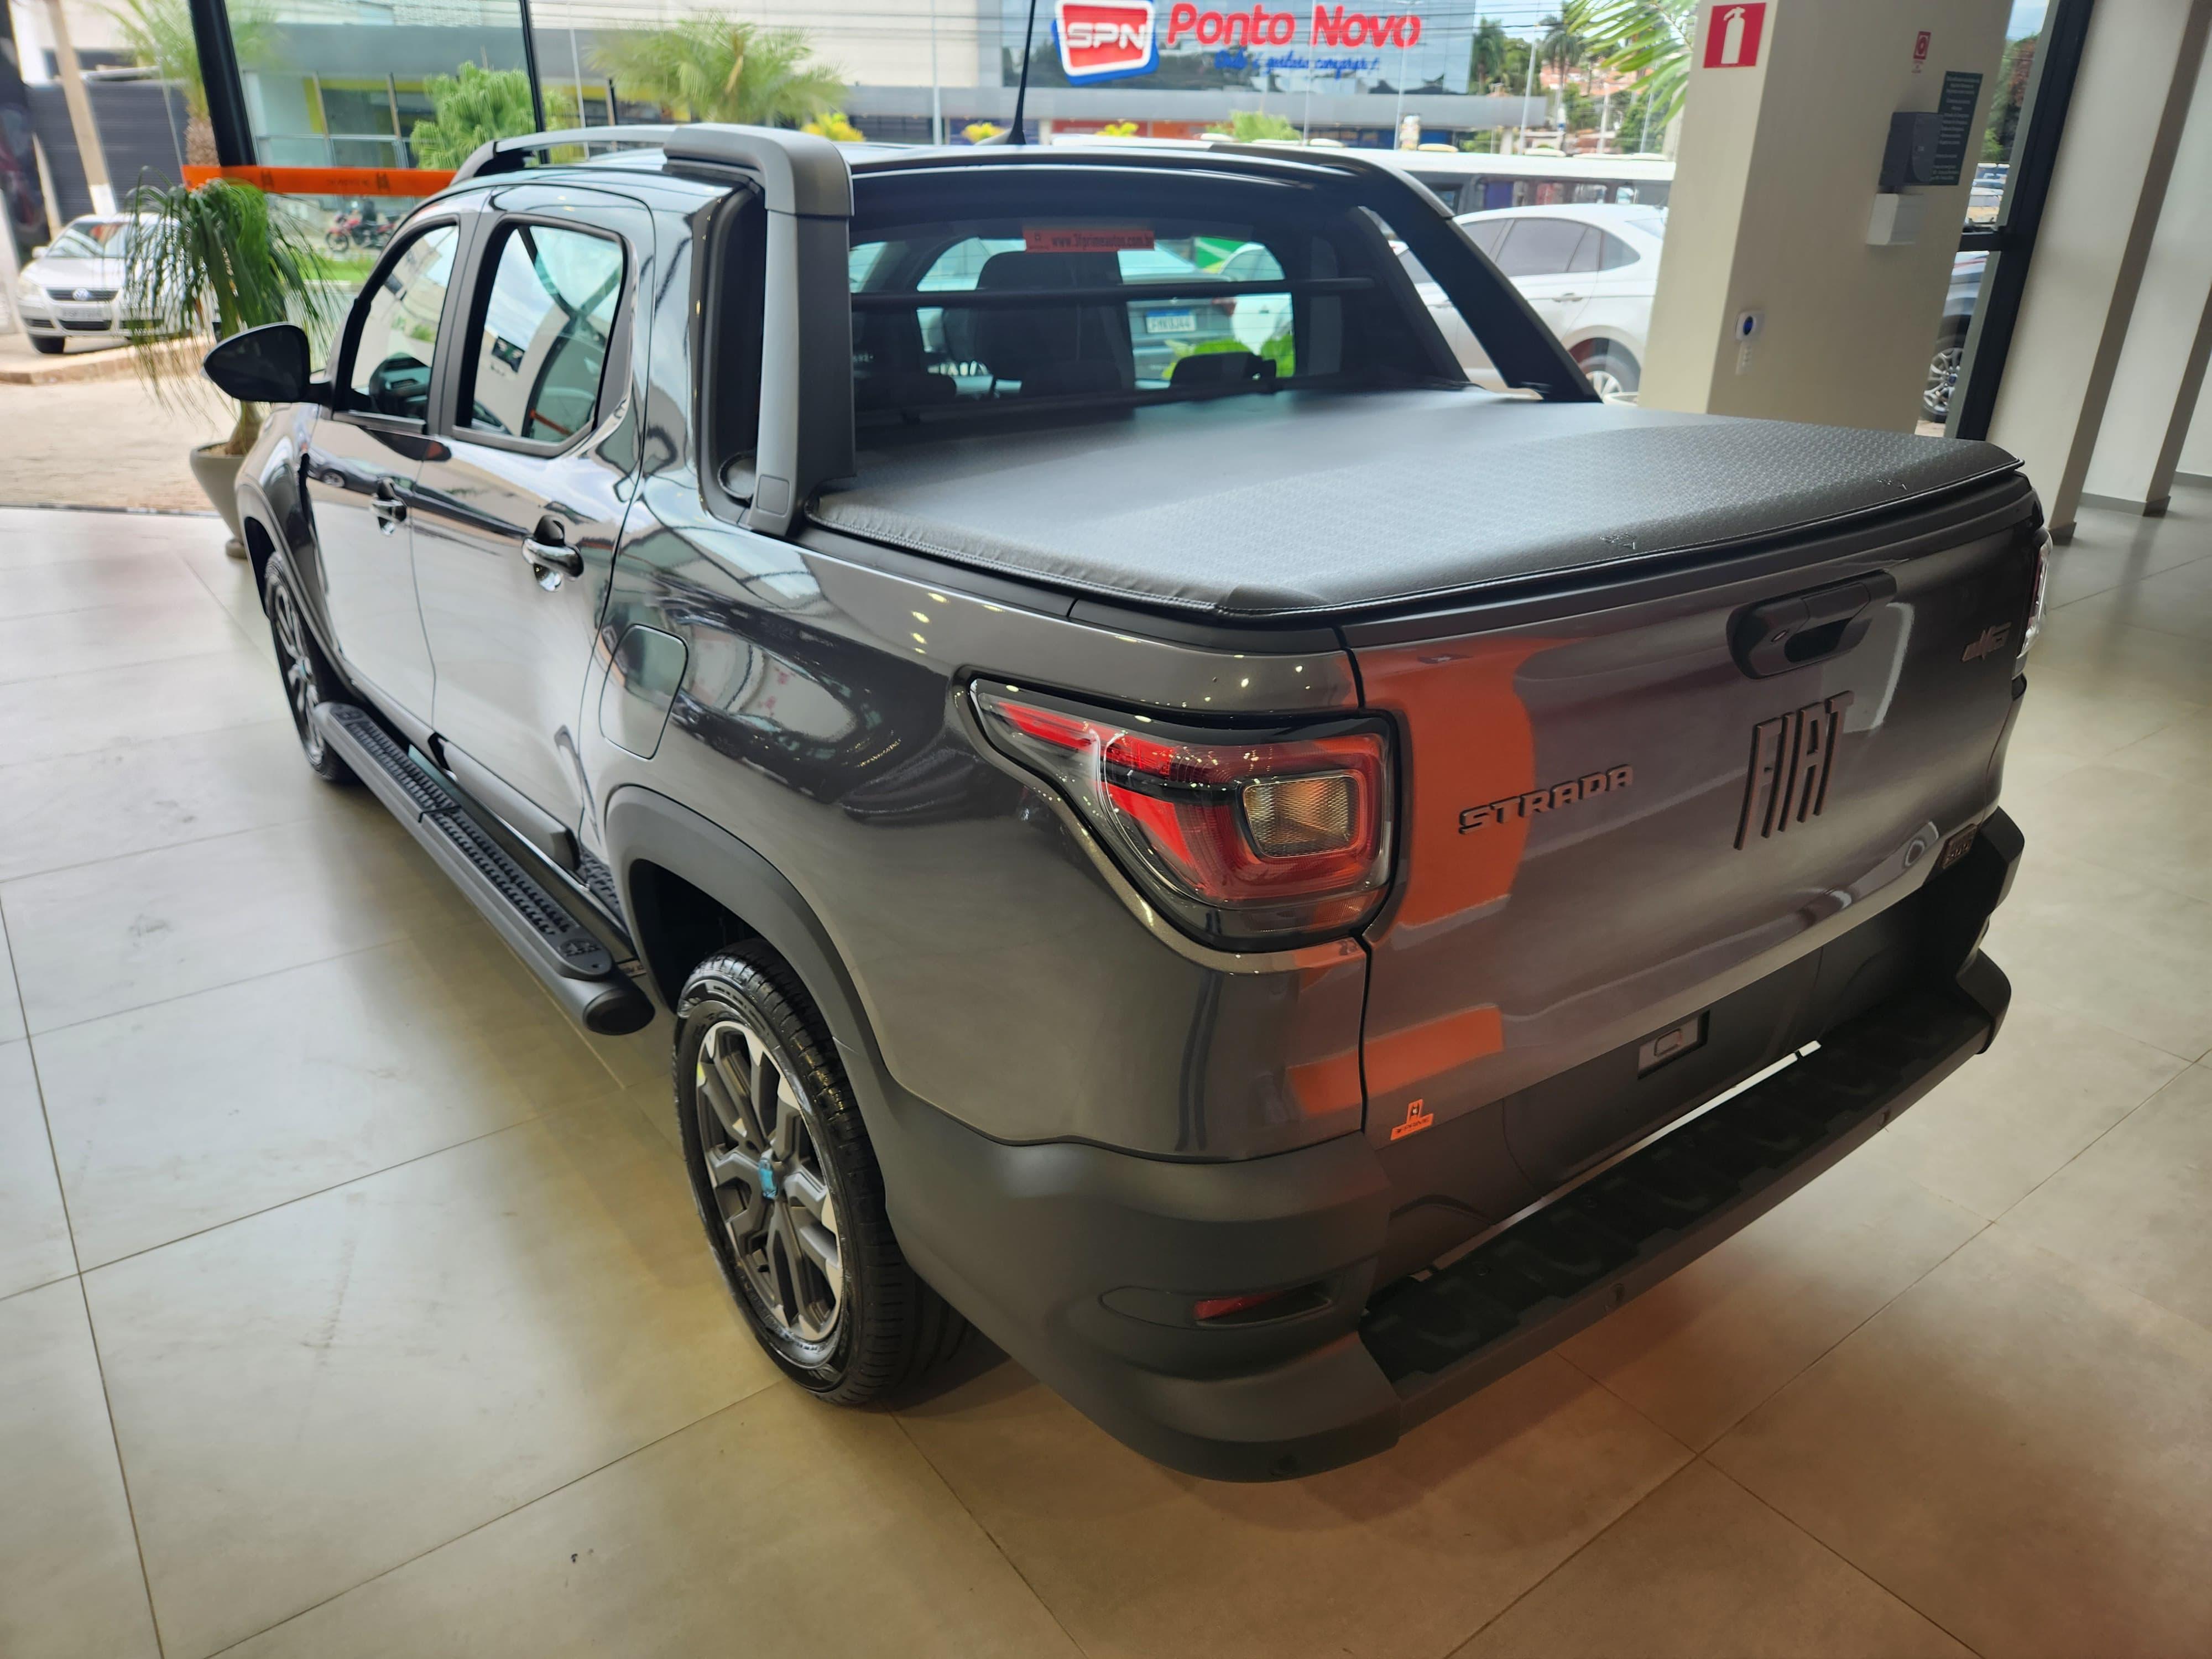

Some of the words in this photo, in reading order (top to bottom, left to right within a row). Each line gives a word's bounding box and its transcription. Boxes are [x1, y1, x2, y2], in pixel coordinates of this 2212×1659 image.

[1067, 22, 1149, 50] SPN
[1166, 3, 1296, 46] Ponto
[1311, 4, 1421, 49] Novo
[1459, 764, 1633, 834] STRADA
[1733, 690, 1855, 851] FIAT
